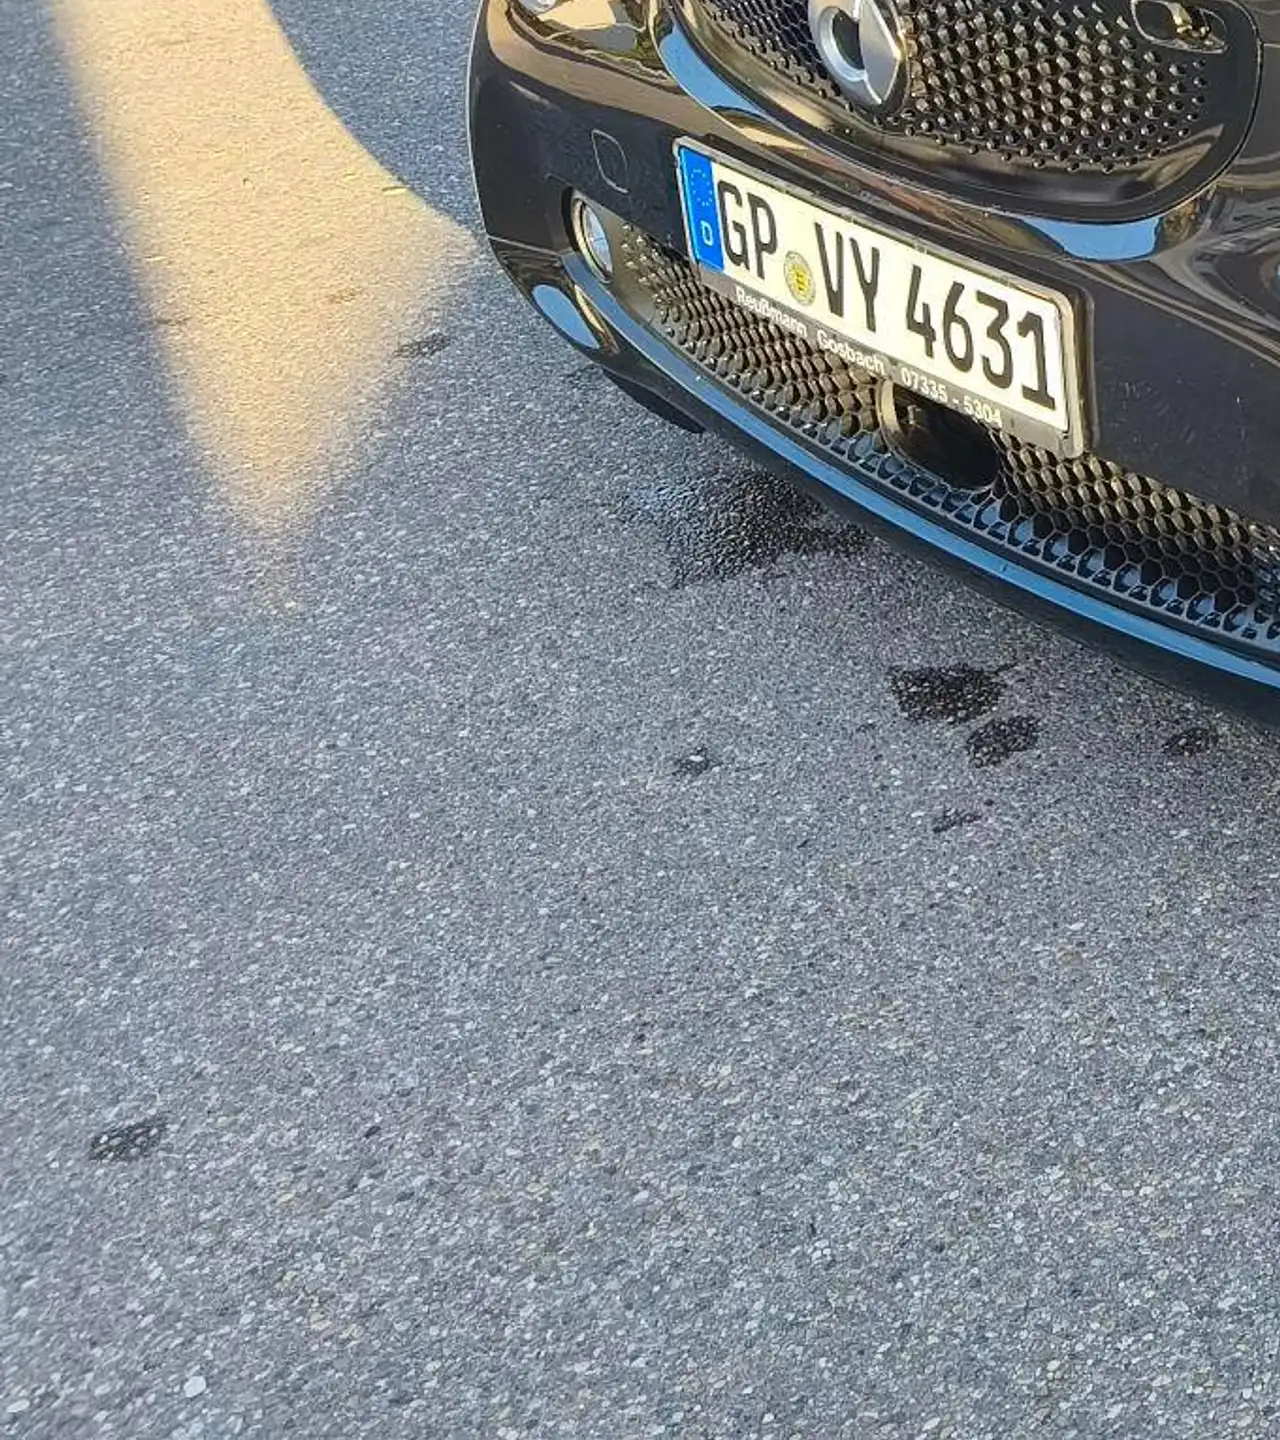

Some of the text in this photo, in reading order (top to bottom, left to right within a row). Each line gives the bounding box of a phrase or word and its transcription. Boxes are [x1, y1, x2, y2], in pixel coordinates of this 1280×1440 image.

[700, 220, 713, 246] D
[717, 180, 1056, 410] GP VY 4631
[817, 329, 885, 375] Gosbach
[901, 367, 948, 403] 07335
